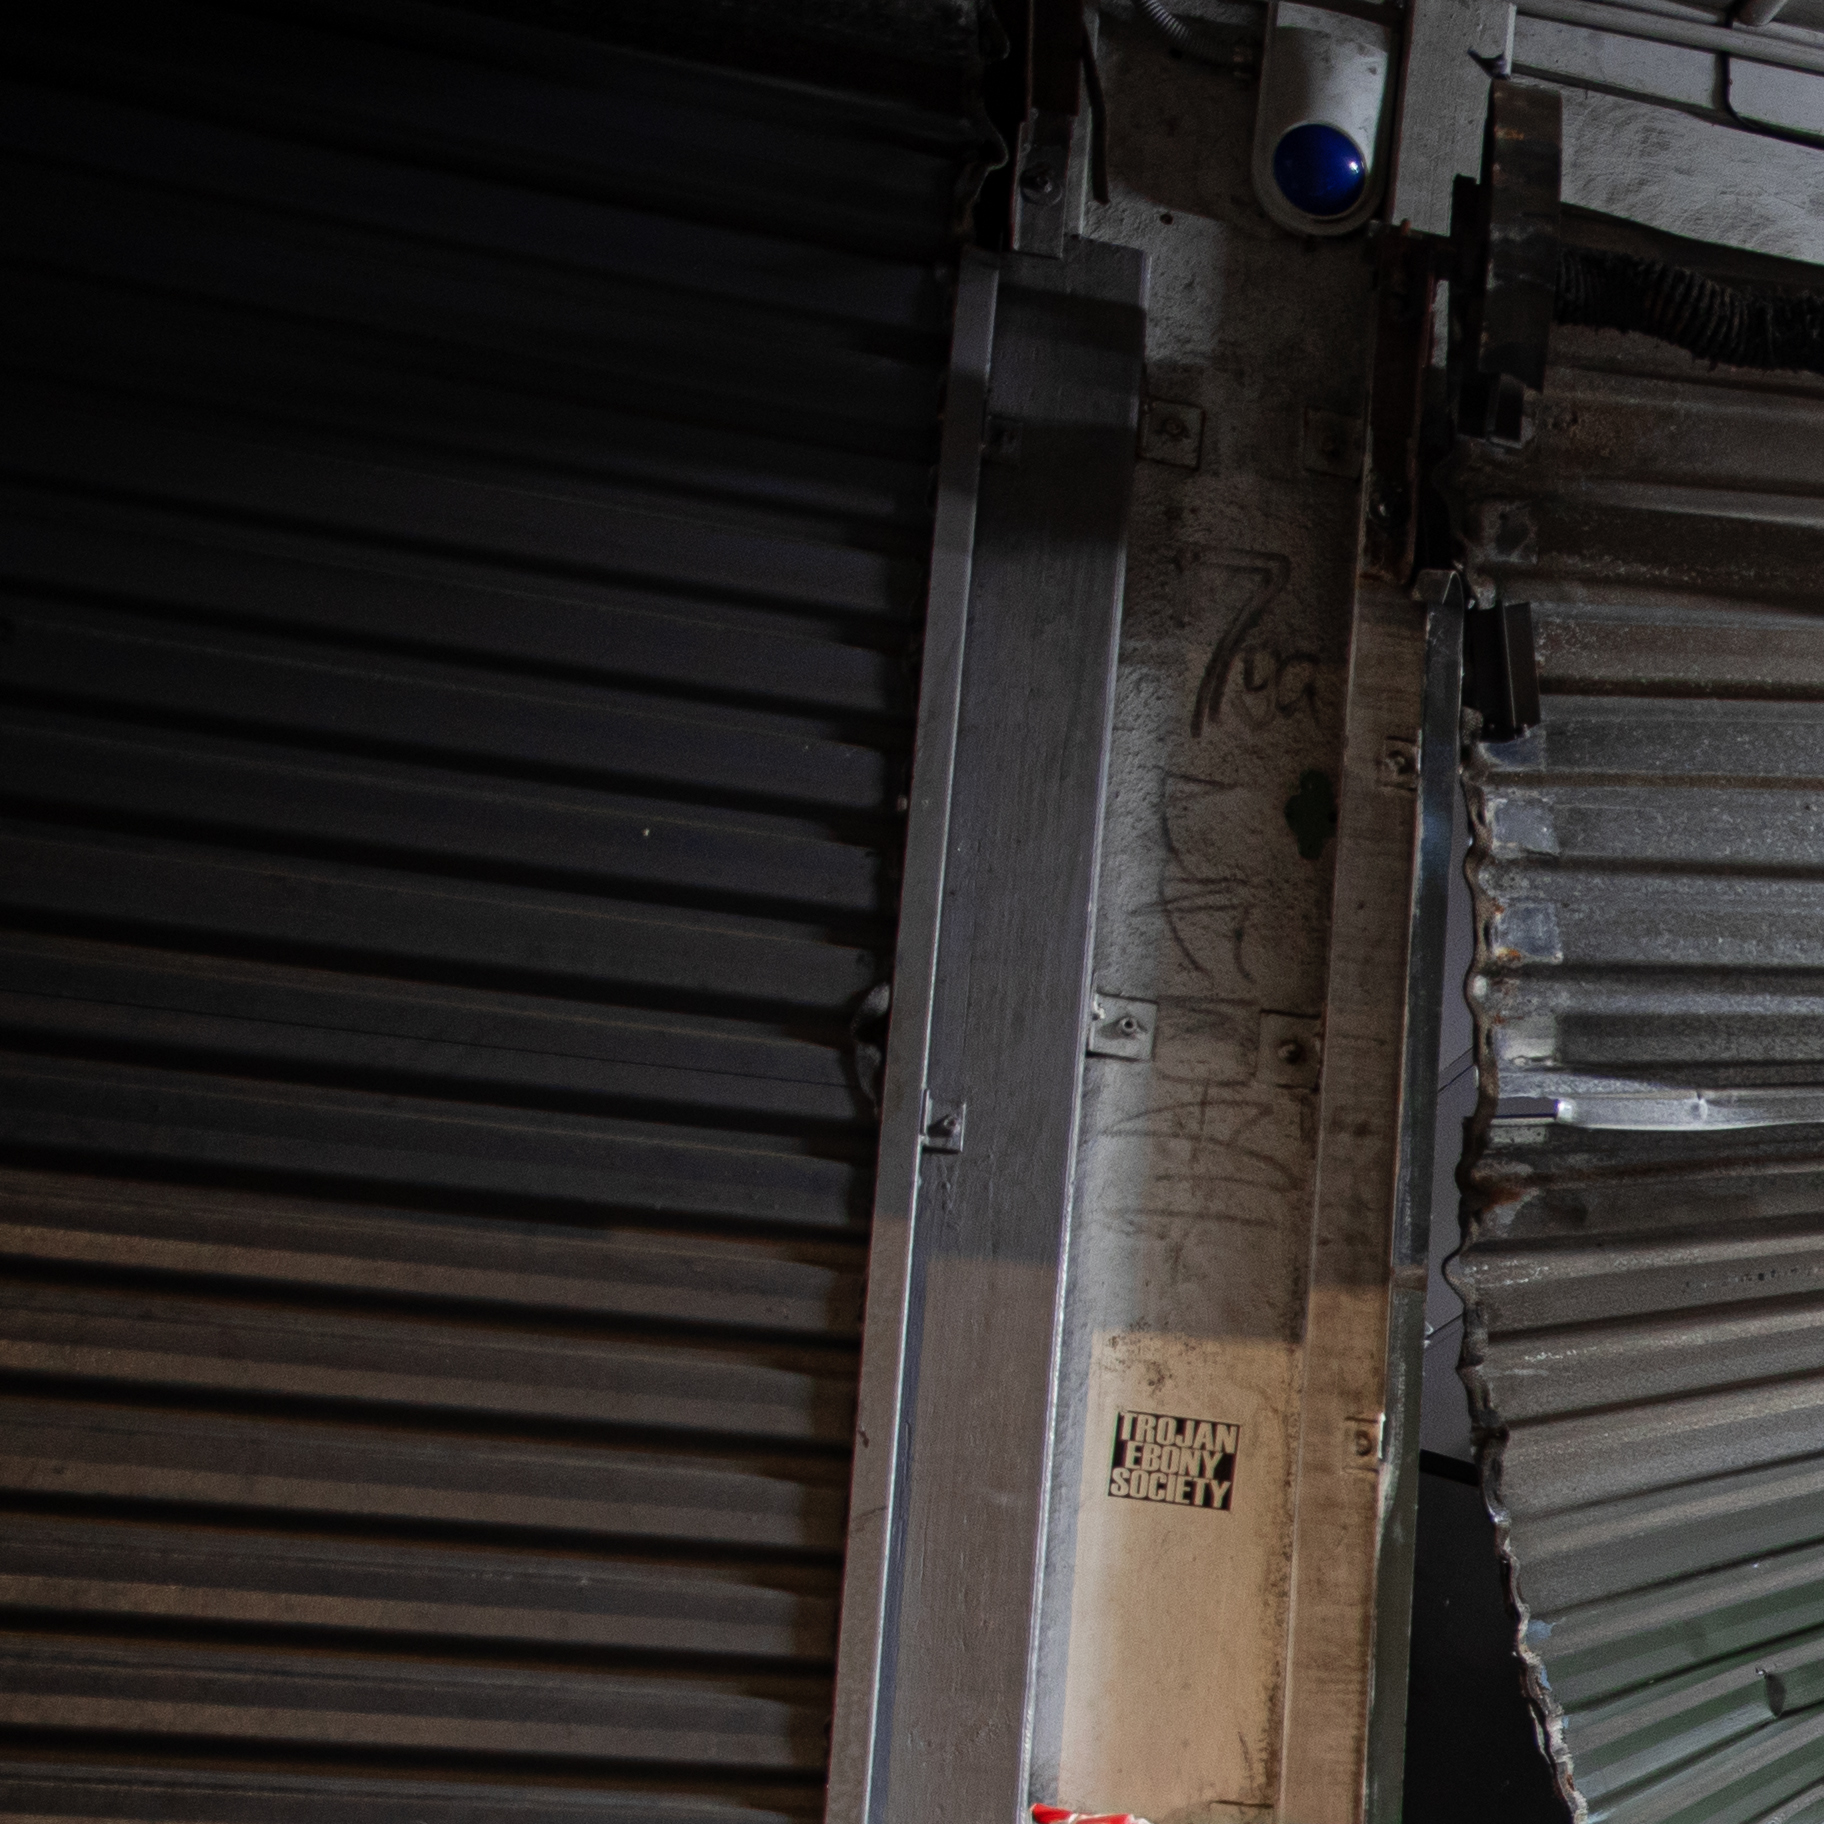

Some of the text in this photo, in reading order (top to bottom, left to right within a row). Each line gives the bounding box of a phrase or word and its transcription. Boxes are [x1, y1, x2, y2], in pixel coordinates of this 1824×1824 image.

[1119, 1411, 1238, 1454] TROJAN
[1125, 1441, 1224, 1479] EBONY
[1110, 1467, 1231, 1508] SOCIETY
